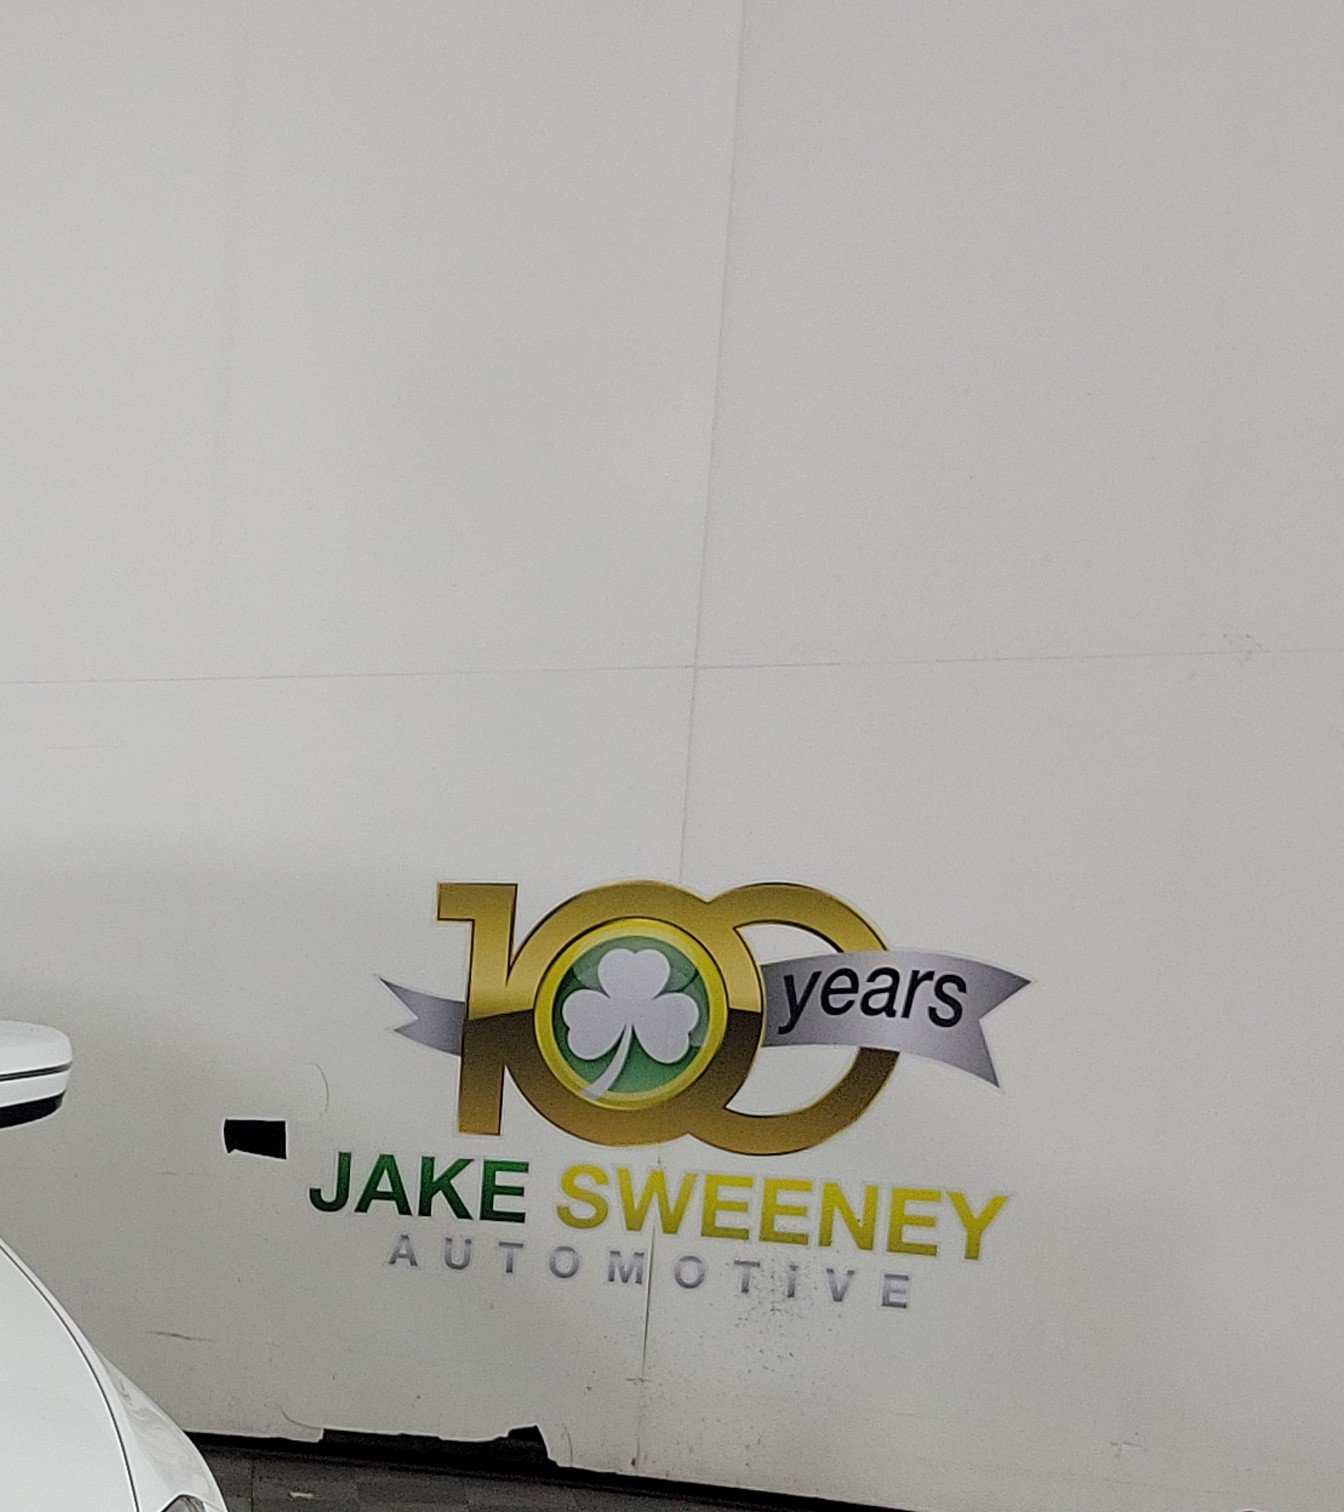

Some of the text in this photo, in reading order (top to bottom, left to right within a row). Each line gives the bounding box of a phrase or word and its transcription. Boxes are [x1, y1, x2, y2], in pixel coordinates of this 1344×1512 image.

[777, 965, 968, 1033] years
[309, 1152, 1008, 1261] JAKE SWEENEY
[388, 1235, 911, 1308] AUTOMOTIVE
